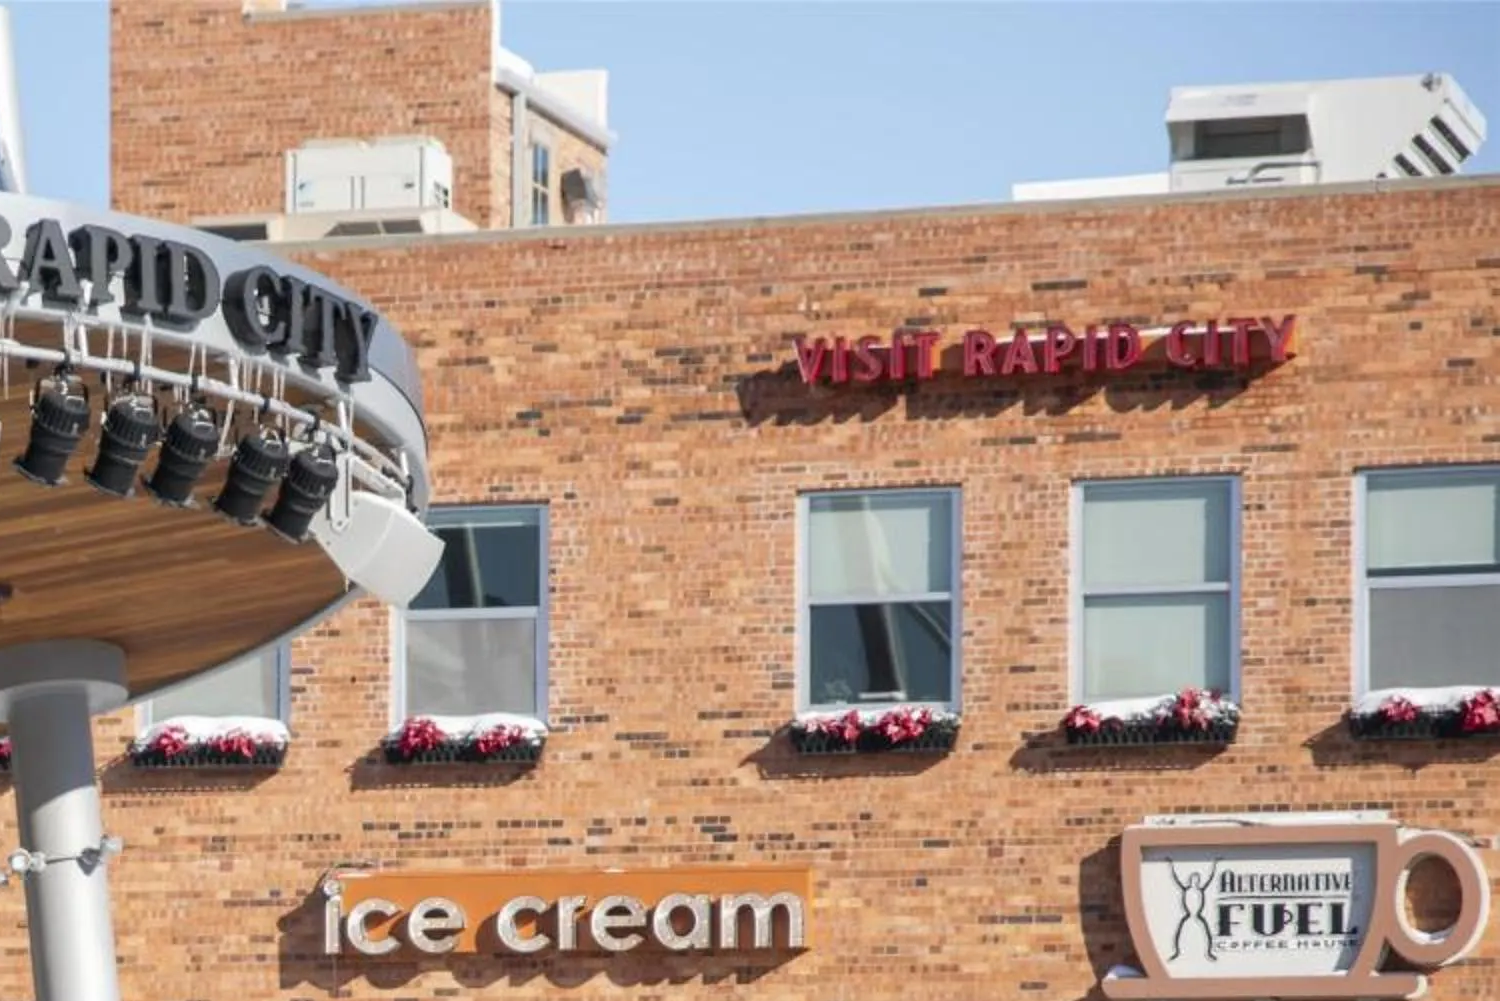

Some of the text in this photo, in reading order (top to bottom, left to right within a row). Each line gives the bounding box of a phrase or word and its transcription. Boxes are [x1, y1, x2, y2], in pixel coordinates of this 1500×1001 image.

[222, 265, 380, 385] CITY
[792, 313, 1296, 384] VISIT RAPID CITY
[323, 879, 806, 956] ice cream
[1218, 902, 1359, 937] FUEL
